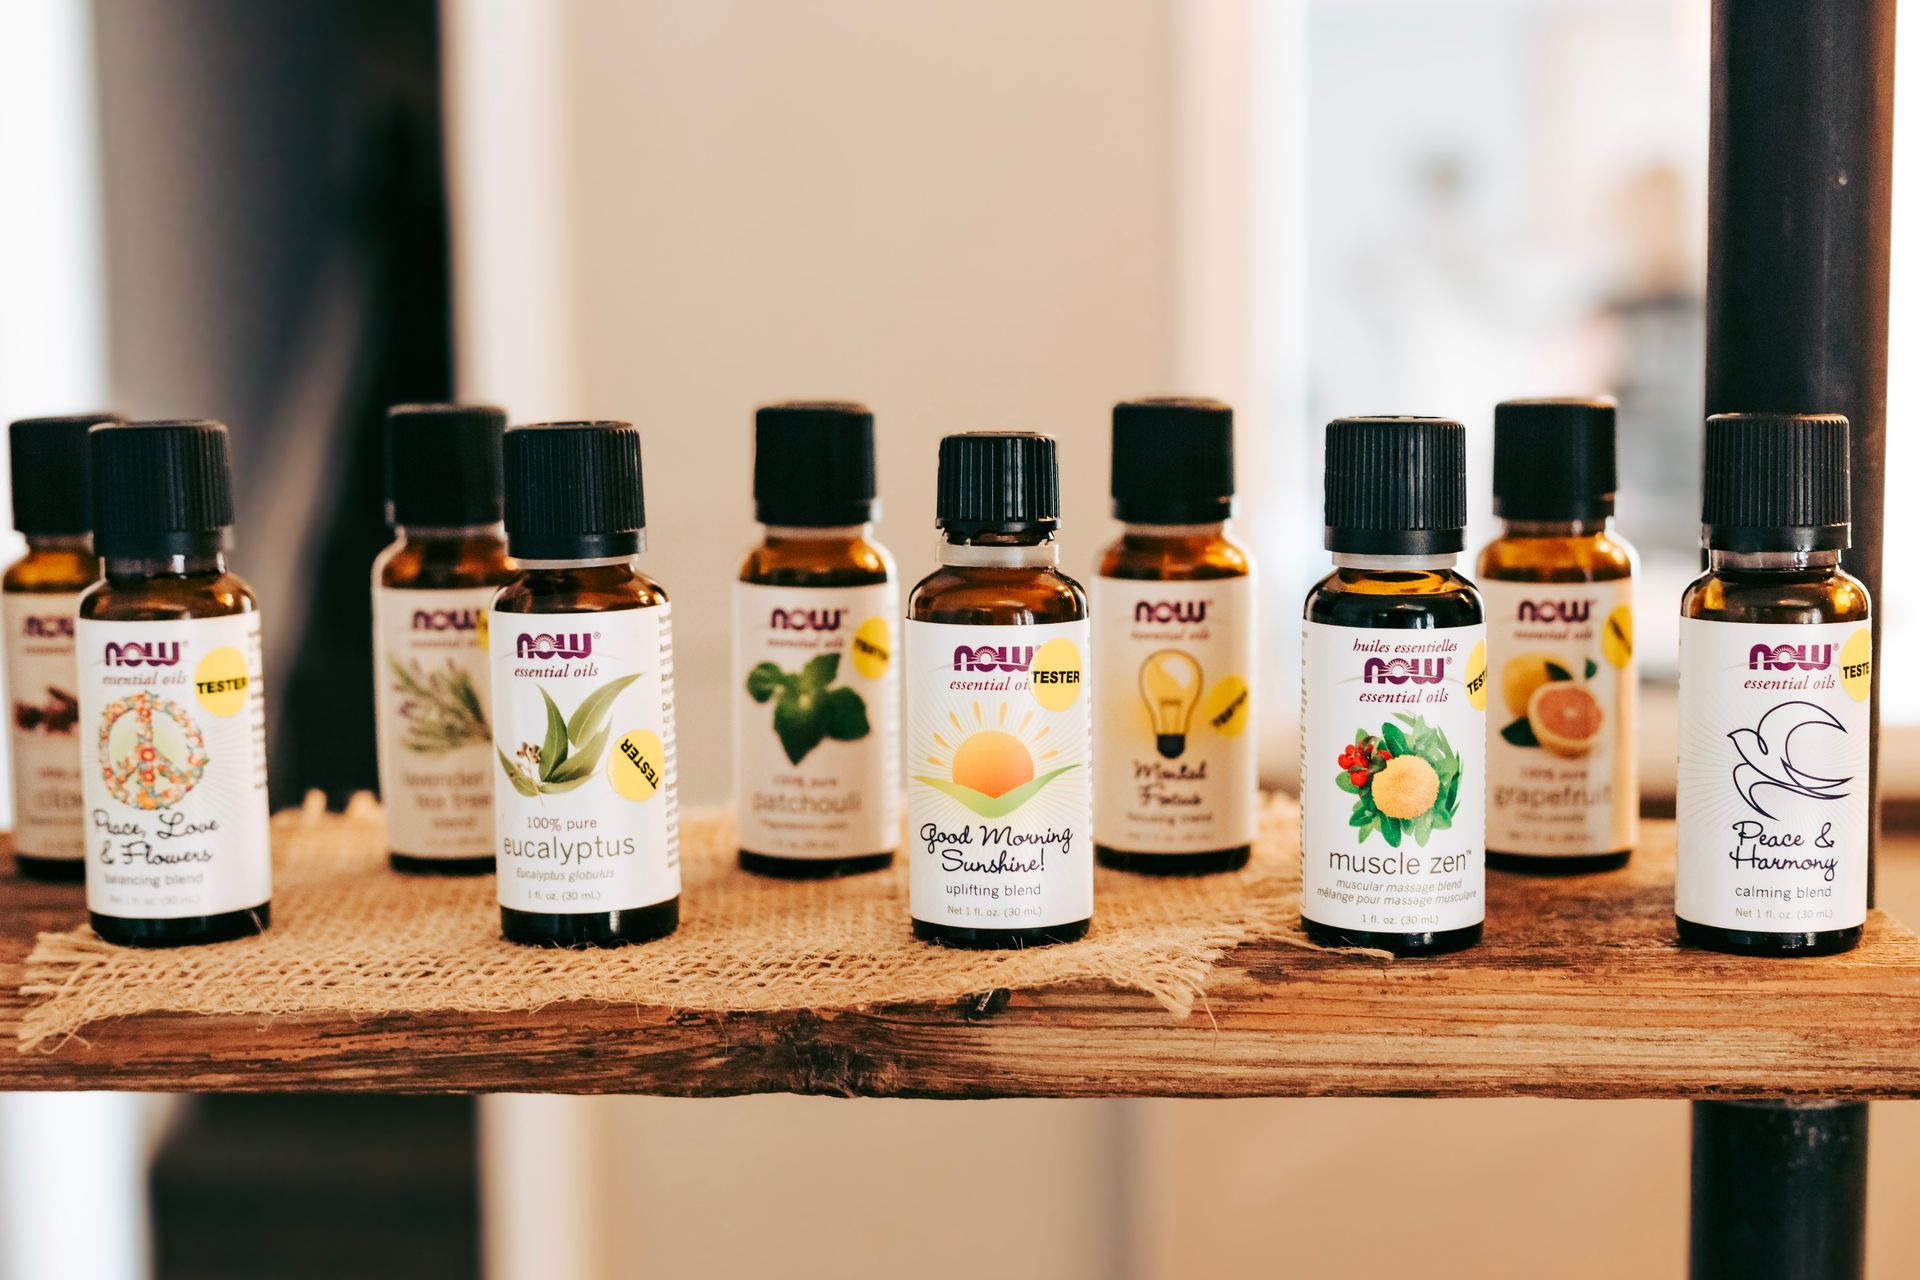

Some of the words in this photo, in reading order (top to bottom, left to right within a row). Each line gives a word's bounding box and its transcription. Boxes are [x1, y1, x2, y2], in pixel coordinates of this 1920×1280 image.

[1352, 638, 1391, 653] huiles
[1394, 638, 1458, 654] essentielles
[102, 671, 159, 686] essential
[162, 670, 188, 686] oils
[515, 663, 570, 679] essential
[574, 662, 599, 678] oils
[1031, 670, 1080, 684] TESTER
[1843, 661, 1870, 680] TESTE
[949, 676, 1011, 691] essential
[1015, 678, 1031, 691] oi
[1466, 664, 1488, 696] TEST
[1743, 676, 1809, 691] essential
[1813, 675, 1836, 690] oils
[1359, 689, 1421, 705] essential
[1426, 690, 1449, 704] oils
[620, 738, 660, 790] TESTER
[1133, 760, 1207, 781] Mental
[752, 791, 862, 816] patchouli
[1139, 783, 1203, 807] Focus
[1494, 783, 1613, 809] grapefruit
[93, 809, 147, 838] Peace,
[157, 812, 220, 840] Love
[527, 816, 562, 832] 100%
[566, 819, 598, 832] pure
[920, 822, 973, 854] Good
[979, 824, 1074, 854] Morning
[1732, 820, 1805, 848] Peace
[1814, 821, 1836, 849] &
[101, 840, 115, 865] &
[121, 840, 214, 866] Flowers
[503, 836, 636, 866] eucalyptus
[941, 847, 1045, 875] Sunshine!
[1329, 851, 1421, 875] muscle
[1729, 843, 1839, 882] Harmony
[105, 873, 161, 889] balancing
[166, 872, 205, 885] blend
[516, 867, 566, 882] Eucalyptus
[568, 867, 616, 883] globulus
[946, 883, 1000, 900] uplifting
[1004, 883, 1042, 897] blend
[1336, 878, 1384, 893] muscular
[1386, 882, 1435, 895] massage
[1437, 878, 1463, 892] blend
[1735, 885, 1792, 902] calming
[1796, 885, 1833, 899] blend
[1316, 886, 1355, 904] mélange
[1356, 894, 1382, 906] pour
[1383, 894, 1433, 908] massage
[1434, 888, 1477, 904] musculaire
[947, 905, 963, 916] Net
[1003, 907, 1021, 918] (30
[1361, 914, 1367, 923] 1
[1400, 914, 1417, 926] (30
[1735, 907, 1753, 918] Net
[1796, 910, 1814, 920] (30
